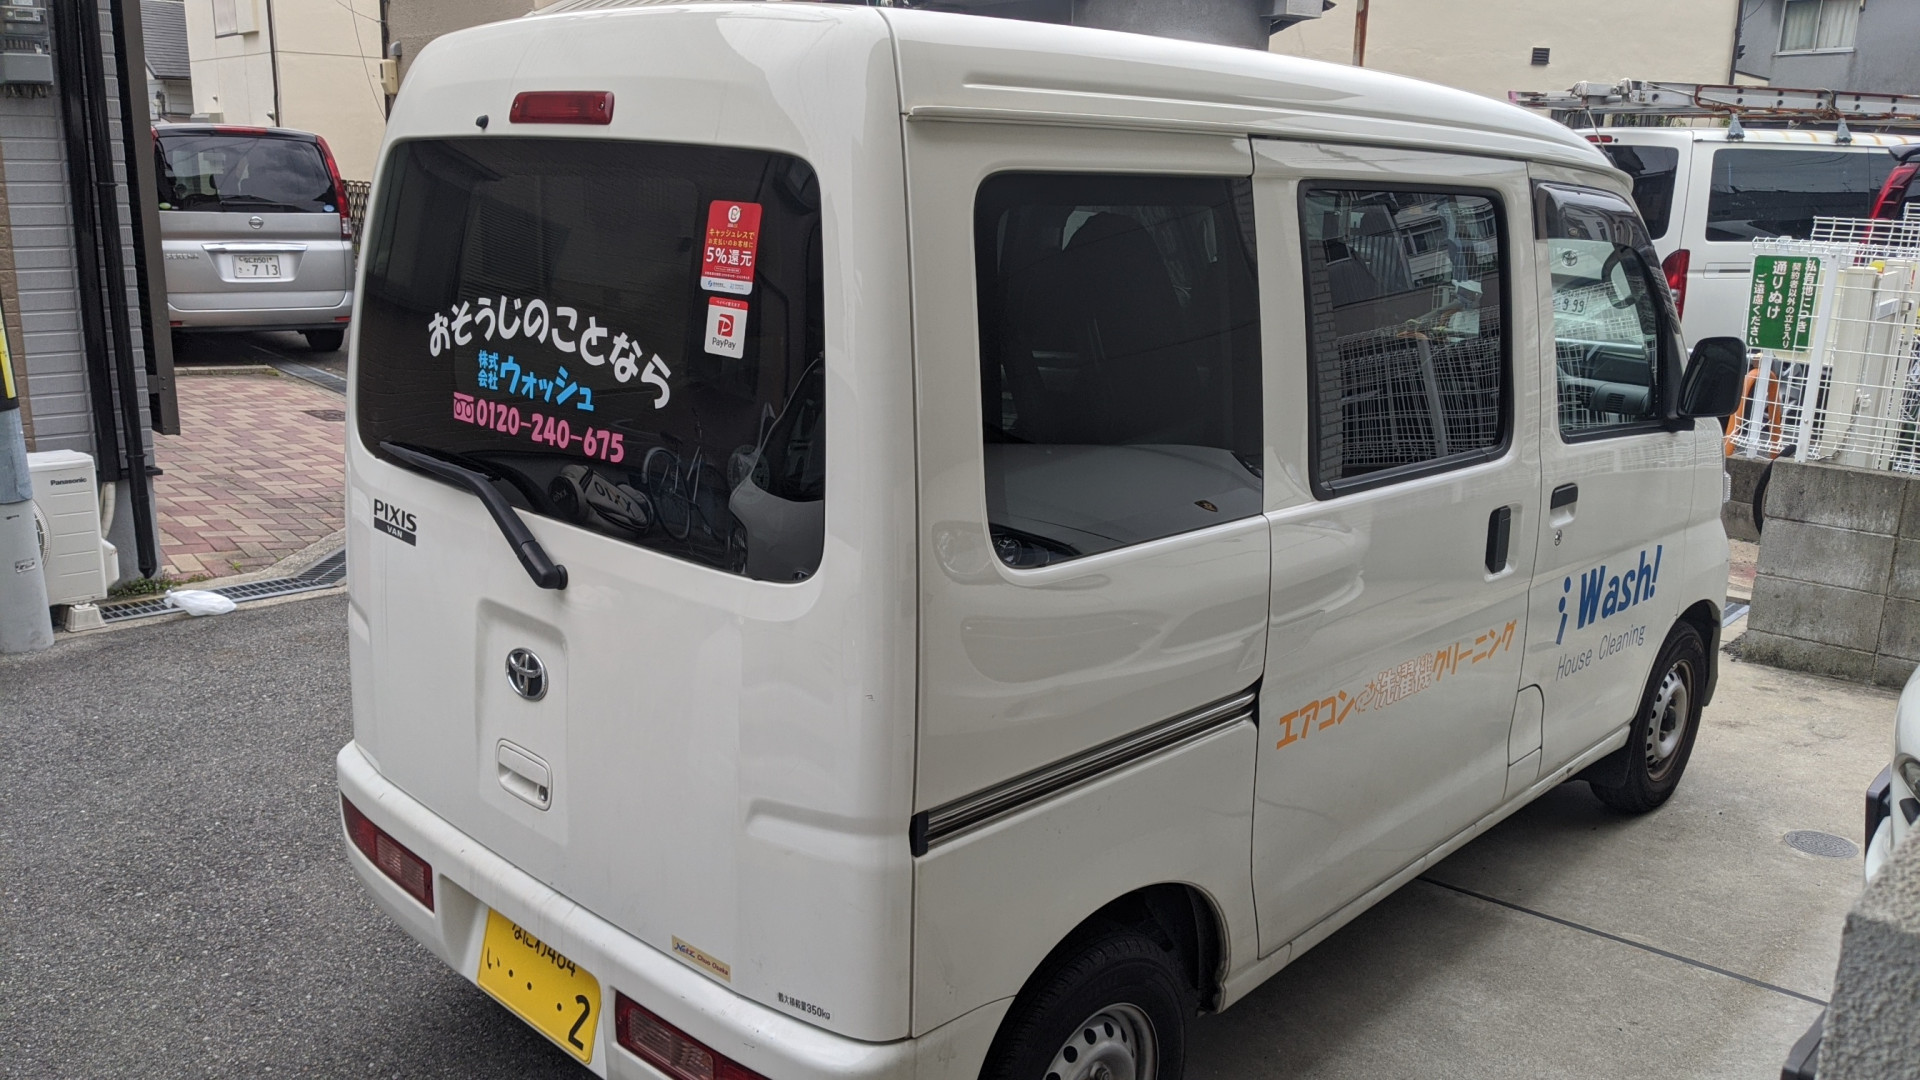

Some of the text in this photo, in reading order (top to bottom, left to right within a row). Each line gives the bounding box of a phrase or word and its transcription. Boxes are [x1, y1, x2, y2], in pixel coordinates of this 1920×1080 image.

[706, 246, 752, 267] 5%還元
[709, 228, 755, 239] キャッシュレスで
[1749, 272, 1767, 346] ご遠慮ください
[1767, 261, 1787, 319] 通りぬけ
[1782, 262, 1802, 349] 契約者以外の立ち入り
[1798, 260, 1817, 333] 私有地につき
[428, 295, 671, 409] おそうじのことなら
[712, 337, 736, 350] PayPay
[500, 355, 594, 411] ウォッシュ
[476, 398, 625, 463] 0120-240-675
[50, 477, 87, 486] Panasonic
[374, 498, 417, 532] PIXIS
[387, 525, 402, 538] VAN
[1577, 545, 1662, 630] Wash!
[1556, 624, 1647, 681] House Cleaning
[675, 942, 695, 958] Netz
[712, 962, 728, 976] Osaka
